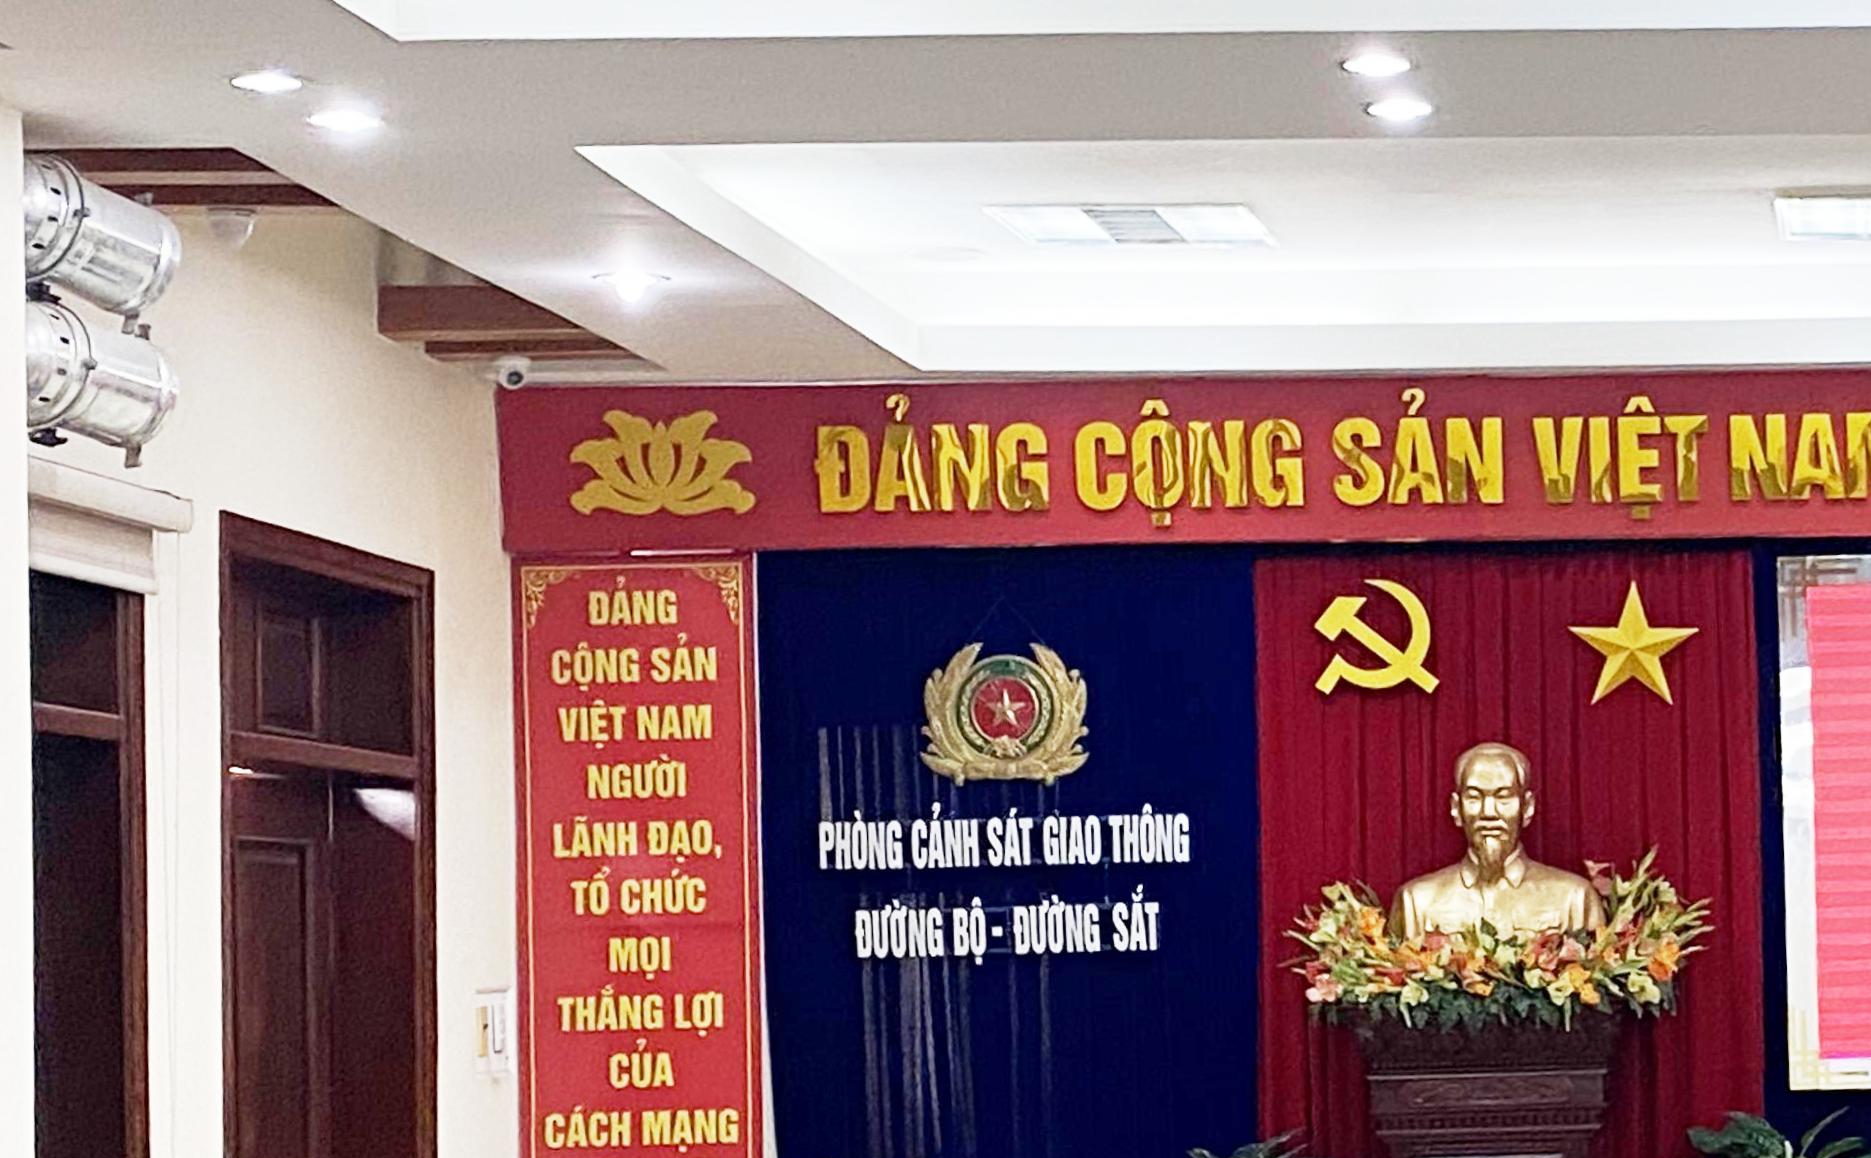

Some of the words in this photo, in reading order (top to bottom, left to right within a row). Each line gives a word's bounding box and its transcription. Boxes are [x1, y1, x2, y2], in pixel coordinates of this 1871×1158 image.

[814, 393, 1050, 513] ĐẢNG
[1075, 399, 1304, 527] CỘNG
[1332, 387, 1504, 506] SẢN
[1533, 395, 1708, 520] VIỆT
[588, 576, 678, 625] ĐẢNG
[552, 641, 640, 691] CỘNG
[651, 633, 717, 682] SẢN
[559, 700, 626, 749] VIỆT
[636, 705, 712, 741] NAM
[587, 753, 686, 799] NGƯỜI
[553, 816, 637, 858] LÃNH
[648, 820, 721, 863] ĐẠO,
[819, 809, 903, 870] PHÒNG
[911, 802, 980, 869] CẢNH
[986, 807, 1033, 867] SÁT
[1043, 814, 1101, 865] GIAO
[1108, 803, 1190, 864] THÔNG
[571, 867, 610, 915] TỔ
[620, 868, 706, 914] CHỨC
[855, 899, 944, 958] ĐƯỜNG
[1013, 894, 1101, 954] ĐƯỜNG
[1112, 884, 1159, 951] SẮT
[608, 937, 671, 979] MỌI
[558, 985, 663, 1031] THẮNG
[675, 991, 723, 1037] LỢI
[609, 1039, 675, 1088] CỦA
[545, 1106, 631, 1149] CÁCH
[642, 1108, 739, 1152] MẠNG
